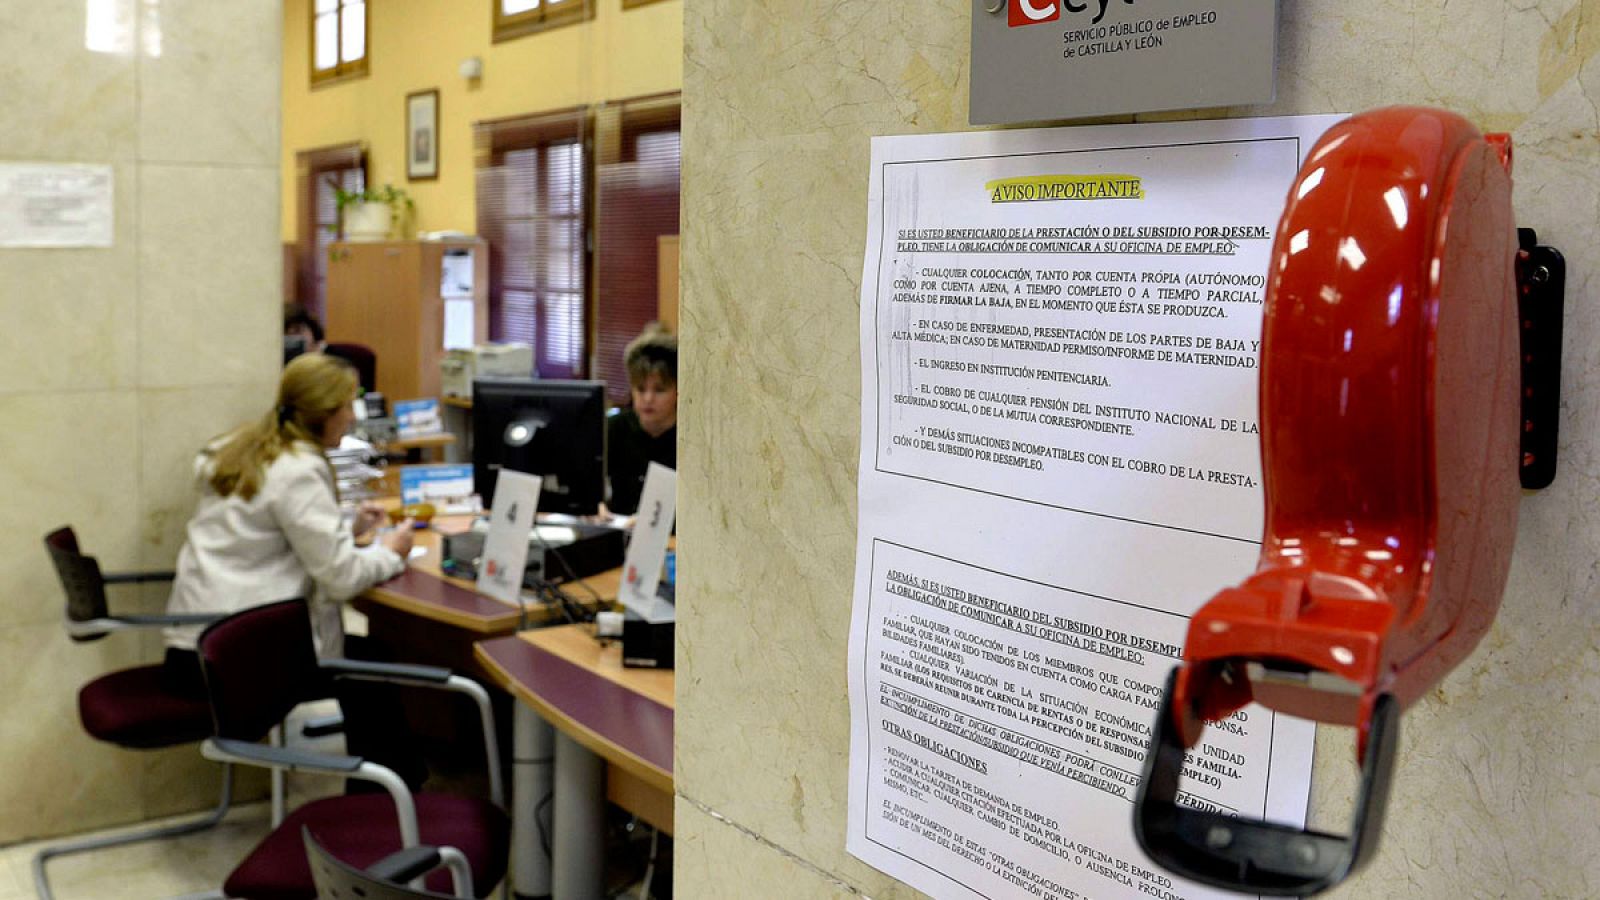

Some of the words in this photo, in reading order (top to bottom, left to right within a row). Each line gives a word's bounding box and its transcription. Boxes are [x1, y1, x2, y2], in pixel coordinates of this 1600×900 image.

[1063, 26, 1105, 42] SERVICIO
[1109, 20, 1152, 36] PÚBLICO
[1156, 18, 1169, 30] de
[1172, 11, 1216, 27] EMPLEO
[1063, 46, 1074, 58] de
[1078, 40, 1122, 56] CASTILLA
[1123, 39, 1131, 50] Y
[1135, 34, 1162, 48] LEÓN
[992, 185, 1034, 200] AVISO
[1037, 181, 1140, 198] IMPORTANTE
[898, 229, 906, 238] SI
[907, 229, 916, 238] ES
[918, 228, 943, 238] USTED
[946, 228, 1006, 238] BENEFICIARIO
[1010, 228, 1021, 237] DE
[1023, 227, 1033, 237] LA
[1037, 225, 1100, 237] PRESTACIÓN
[1102, 227, 1110, 236] O
[1113, 227, 1136, 236] DEL
[1138, 227, 1191, 236] SUBSIDIO
[1194, 227, 1218, 236] POR
[1222, 226, 1270, 236] DESEM-
[922, 241, 944, 250] TIENE
[947, 241, 957, 250] LA
[958, 239, 1014, 250] OBLIGACIÓN
[1016, 241, 1028, 250] DE
[1029, 241, 1092, 251] COMUNICAR
[1094, 242, 1101, 251] A
[1104, 242, 1117, 251] SU
[1119, 242, 1162, 251] OFICINA
[1166, 243, 1182, 252] DE
[922, 267, 968, 278] CUALQUIER
[970, 267, 1033, 279] COLOCACIÓN,
[1036, 270, 1069, 280] TANTO
[1072, 270, 1092, 280] POR
[1095, 271, 1137, 281] CUENTA
[1185, 272, 1266, 285] (AUTÓNOMO)
[893, 290, 925, 303] ADEMÁS
[927, 294, 938, 303] DE
[940, 294, 973, 305] FIRMAR
[975, 296, 987, 306] LA
[989, 296, 1013, 307] BAJA,
[1015, 298, 1028, 308] EN
[1029, 298, 1040, 308] EL
[1042, 299, 1093, 311] MOMENTO
[1095, 301, 1117, 312] QUE
[1119, 300, 1145, 313] ÉSTA
[1147, 304, 1161, 314] SE
[1163, 305, 1228, 317] PRODUZCA.
[892, 330, 912, 341] ALTA
[914, 330, 949, 344] MÉDICA;
[950, 335, 961, 345] EN
[962, 336, 985, 347] CASO
[988, 338, 999, 348] DE
[1000, 339, 1061, 353] MATERNIDAD
[1062, 343, 1155, 360] PERMISO/INFORME
[1157, 351, 1172, 361] DE
[1175, 352, 1258, 367] MATERNIDAD.
[918, 319, 930, 329] EN
[931, 320, 954, 330] CASO
[956, 321, 968, 331] DE
[970, 322, 1032, 336] ENFERMEDAD,
[1034, 327, 1106, 341] PRESENTACIÓN
[1109, 332, 1123, 342] DE
[1126, 333, 1146, 343] LOS
[1150, 334, 1192, 346] PARTES
[1195, 338, 1212, 348] DE
[1215, 339, 1246, 350] BAJA
[1251, 341, 1259, 351] Y
[919, 358, 929, 368] EL
[930, 359, 966, 371] INGRESO
[967, 362, 978, 373] EN
[980, 364, 1034, 378] INSTITUCIÓN
[1036, 369, 1112, 386] PENITENCIARIA.
[921, 383, 931, 393] EL
[933, 385, 961, 397] COBRO
[964, 388, 975, 399] DE
[978, 390, 1027, 405] CUALQUIER
[1030, 396, 1069, 410] PENSIÓN
[1072, 402, 1091, 413] DEL
[1095, 405, 1151, 421] INSTITUTO
[1155, 412, 1216, 428] NACIONAL
[1220, 420, 1237, 431] DE
[1242, 422, 1259, 433] LA
[919, 426, 926, 436] Y
[927, 427, 956, 441] DEMÁS
[957, 432, 1010, 450] SITUACIONES
[1011, 441, 1084, 461] INCOMPATIBLES
[1087, 453, 1110, 465] CON
[1111, 457, 1125, 468] EL
[1127, 459, 1166, 474] COBRO
[1170, 466, 1185, 477] DE
[1188, 468, 1204, 480] LA
[1207, 471, 1257, 487] PRESTA-
[505, 501, 518, 524] 4
[886, 582, 899, 594] LA
[899, 585, 947, 608] OBLIGACIÓN
[949, 599, 960, 611] DE
[960, 603, 1013, 628] COMUNICAR
[1015, 620, 1022, 631] A
[1024, 623, 1037, 635] SU
[1040, 627, 1080, 648] OFICINA
[1082, 640, 1096, 652] DE
[921, 579, 929, 590] SI
[930, 582, 940, 593] ES
[940, 584, 965, 600] USTED
[967, 592, 1029, 617] BENEFICIARIO
[1032, 610, 1052, 623] DEL
[1053, 616, 1103, 637] SUBSIDIO
[1105, 630, 1127, 643] POR
[1131, 636, 1183, 658] DESEMPL
[910, 613, 950, 634] CUALQUIER
[954, 628, 1003, 651] COLOCACIÓN
[1007, 644, 1019, 656] DE
[1022, 649, 1040, 662] LOS
[1044, 656, 1094, 678] MIEMBROS
[1099, 672, 1118, 685] QUE
[882, 719, 913, 739] OTRAS
[914, 732, 987, 773] OBLIGACIONES
